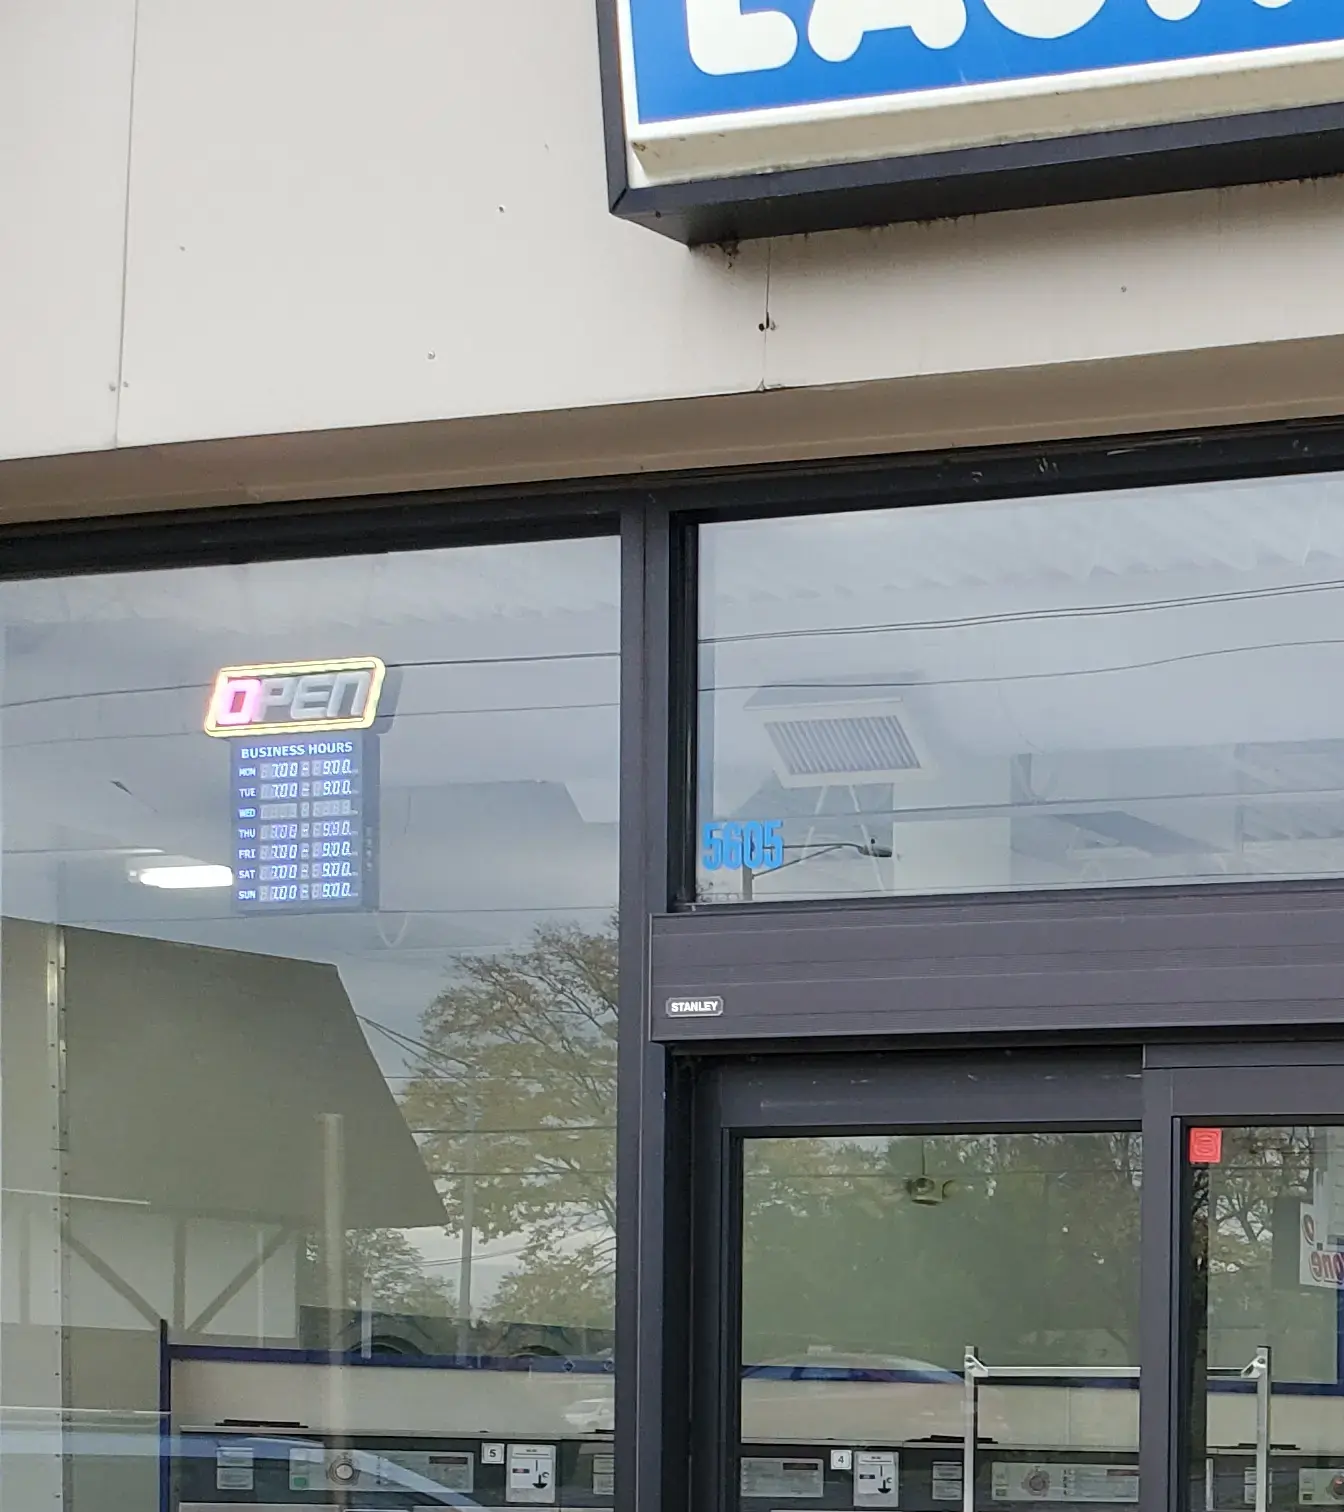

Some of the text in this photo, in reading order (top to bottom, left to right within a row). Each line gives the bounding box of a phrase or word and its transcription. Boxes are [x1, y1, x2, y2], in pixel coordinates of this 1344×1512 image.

[216, 671, 372, 725] OPEN
[241, 741, 353, 759] BUSINESS HOURS
[238, 767, 256, 777] MON
[238, 787, 256, 798] TUE
[238, 828, 256, 838] THU
[702, 819, 785, 871] 5605
[238, 849, 256, 859] FRI
[238, 869, 256, 879] SAT
[238, 890, 256, 900] SUN
[671, 1001, 719, 1013] STANLEY
[489, 1448, 497, 1458] 5
[837, 1455, 845, 1464] 4
